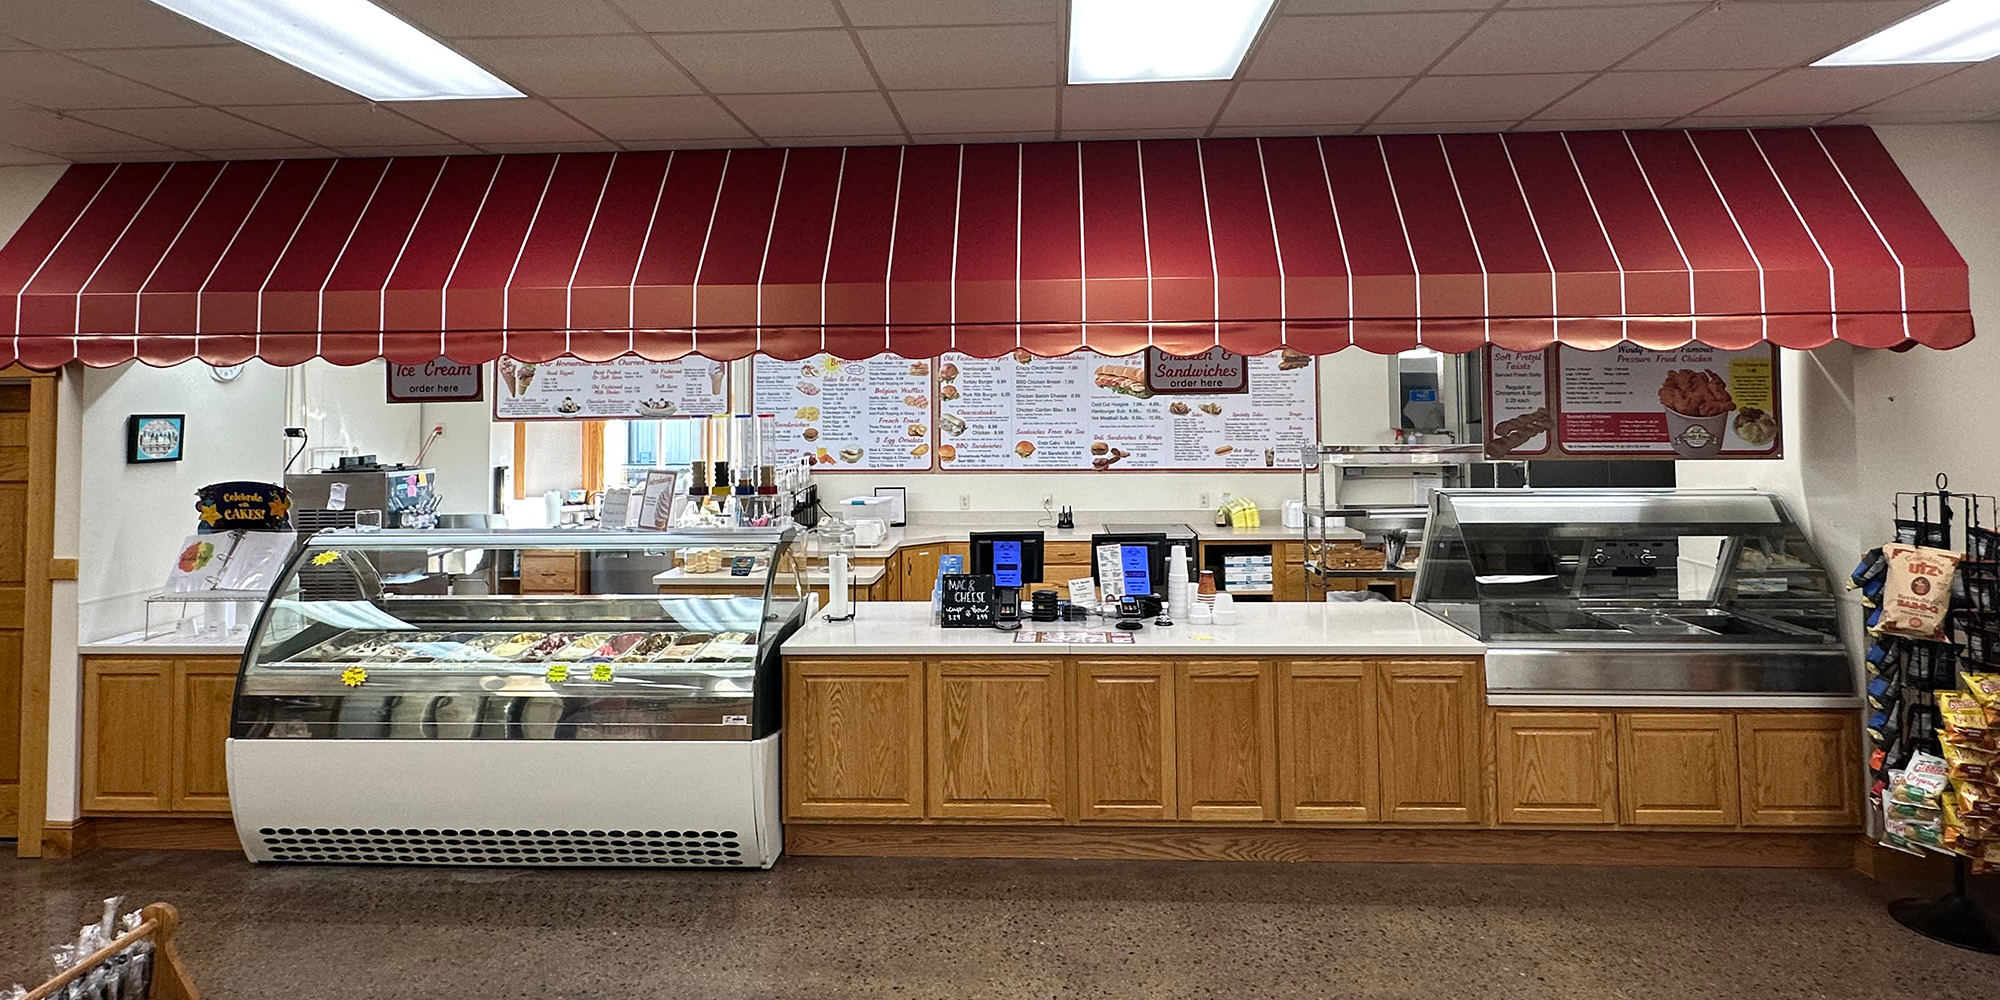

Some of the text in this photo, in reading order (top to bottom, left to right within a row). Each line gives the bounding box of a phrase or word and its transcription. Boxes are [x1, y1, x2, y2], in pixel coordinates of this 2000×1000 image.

[1618, 346, 1643, 355] Windy
[1494, 352, 1542, 364] Soft Pretzel
[396, 360, 472, 377] Ice Cream
[1155, 363, 1238, 378] Sandwiches
[1506, 362, 1531, 370] Twists
[409, 384, 459, 393] order here
[1170, 379, 1223, 388] order here
[874, 388, 898, 396] Belgian
[883, 436, 896, 444] Egg
[223, 492, 263, 503] Celebrate
[224, 509, 266, 520] CAKES!
[948, 580, 976, 592] MAC &
[954, 592, 986, 603] CHEESE
[1906, 772, 1942, 788] Original
